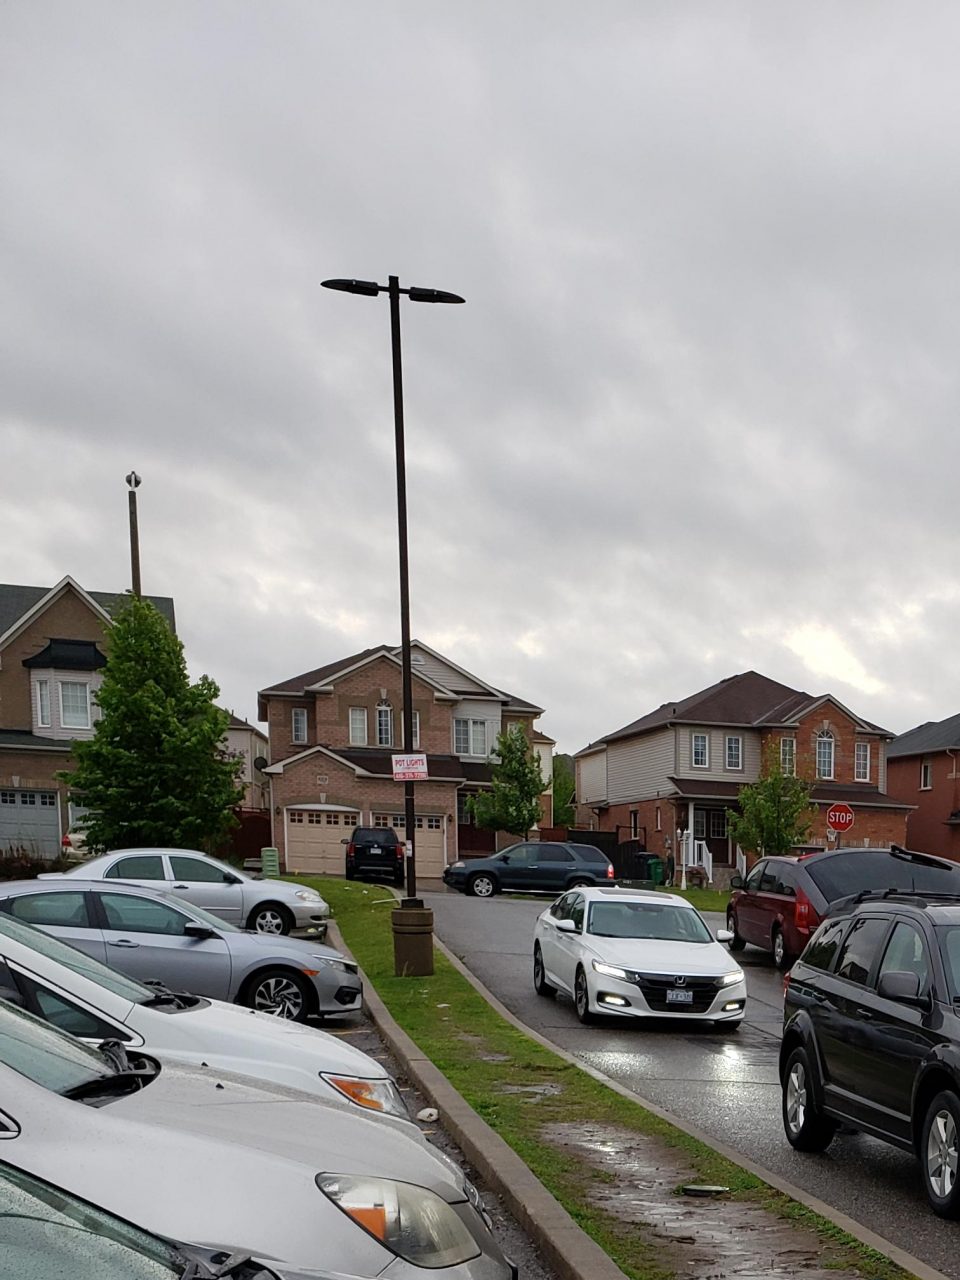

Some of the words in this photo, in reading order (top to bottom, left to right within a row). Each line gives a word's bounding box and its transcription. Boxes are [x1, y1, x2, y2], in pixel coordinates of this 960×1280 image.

[395, 759, 405, 767] POT
[406, 758, 424, 766] LIGHTS
[829, 811, 853, 823] STOP
